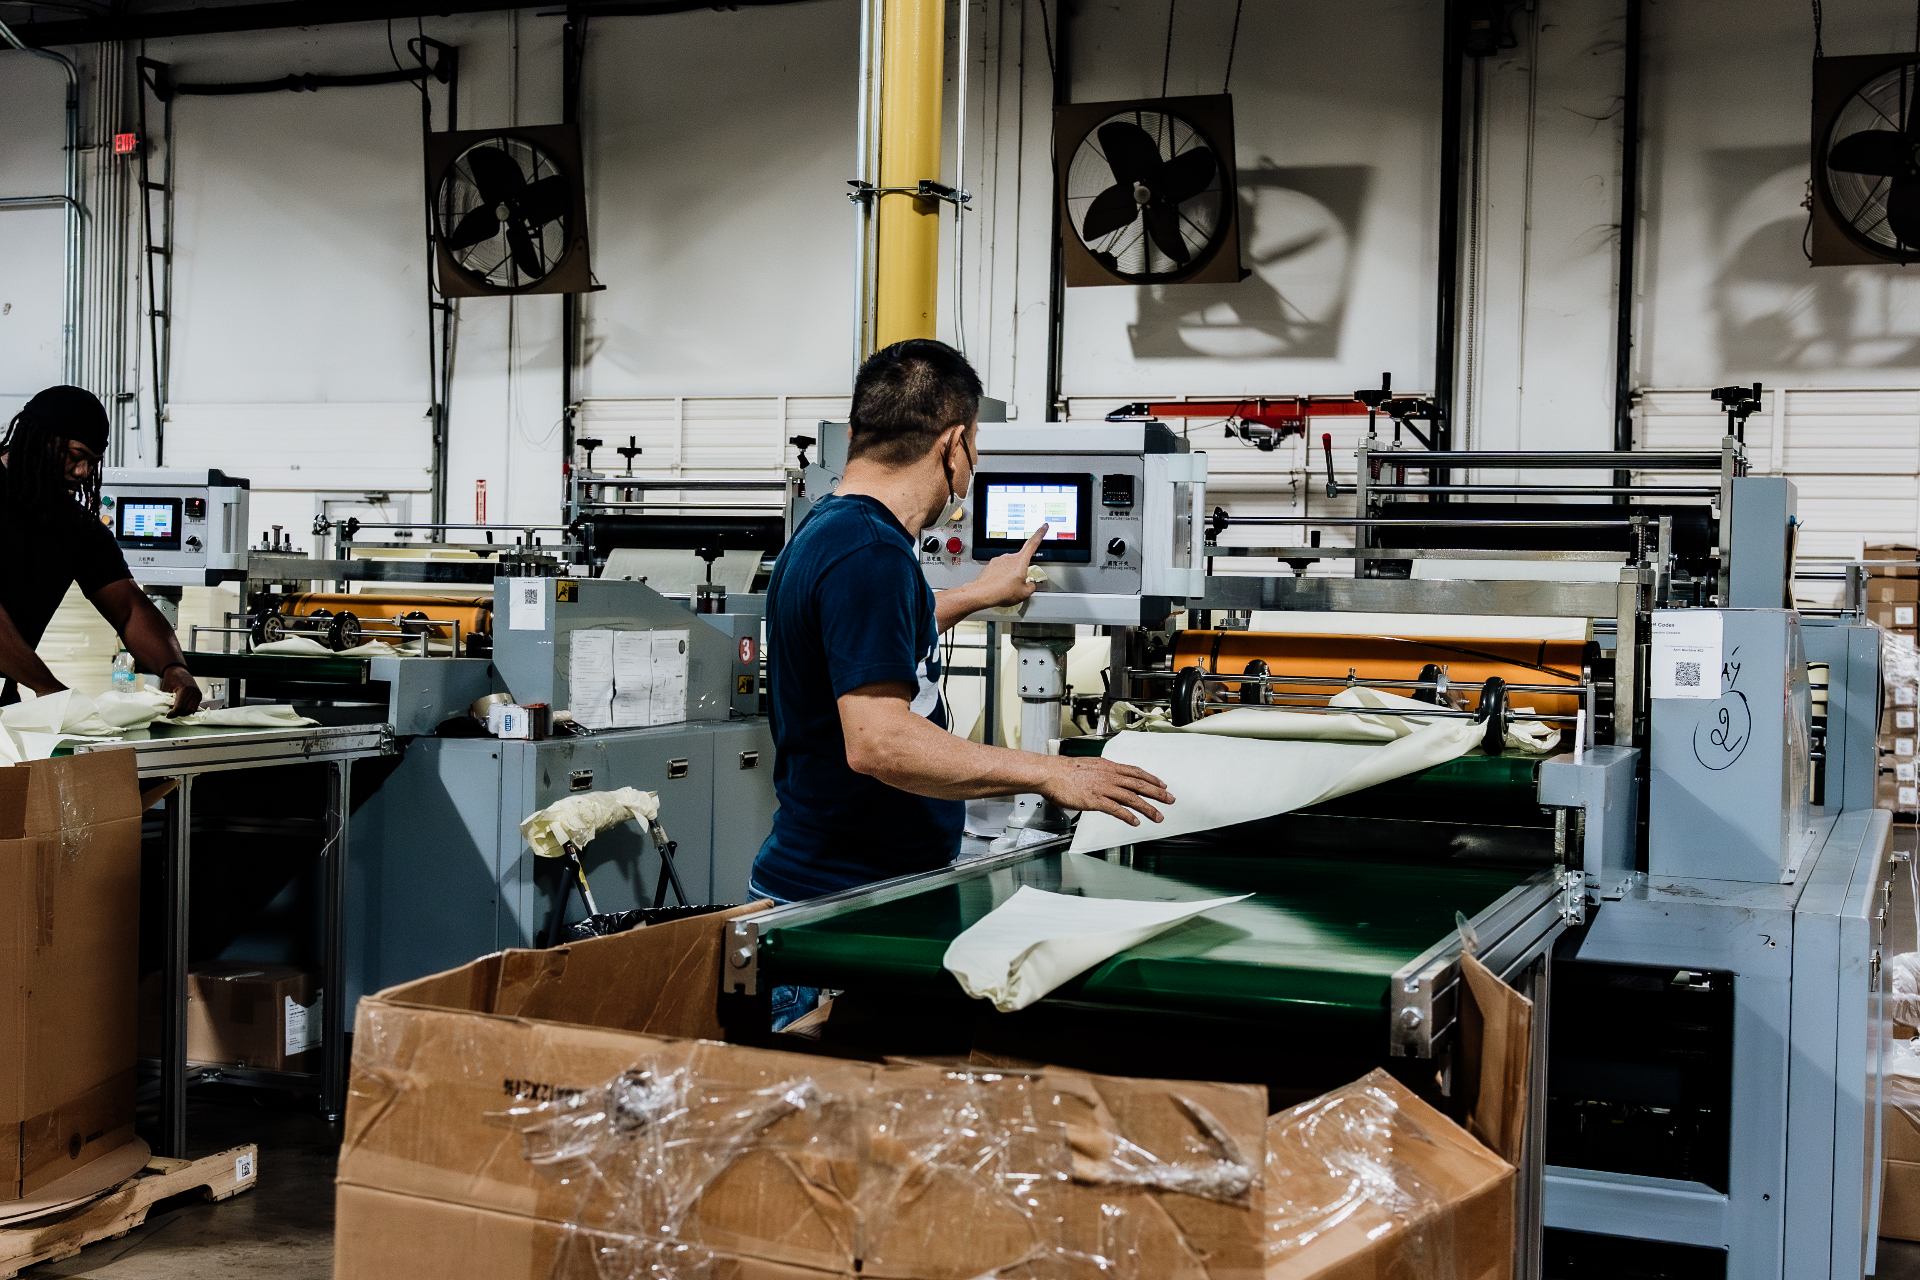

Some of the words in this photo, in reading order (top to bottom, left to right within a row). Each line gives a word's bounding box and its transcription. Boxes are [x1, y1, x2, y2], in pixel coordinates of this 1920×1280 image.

[115, 133, 133, 151] EXIT
[742, 639, 750, 660] 3
[1711, 707, 1742, 752] 2
